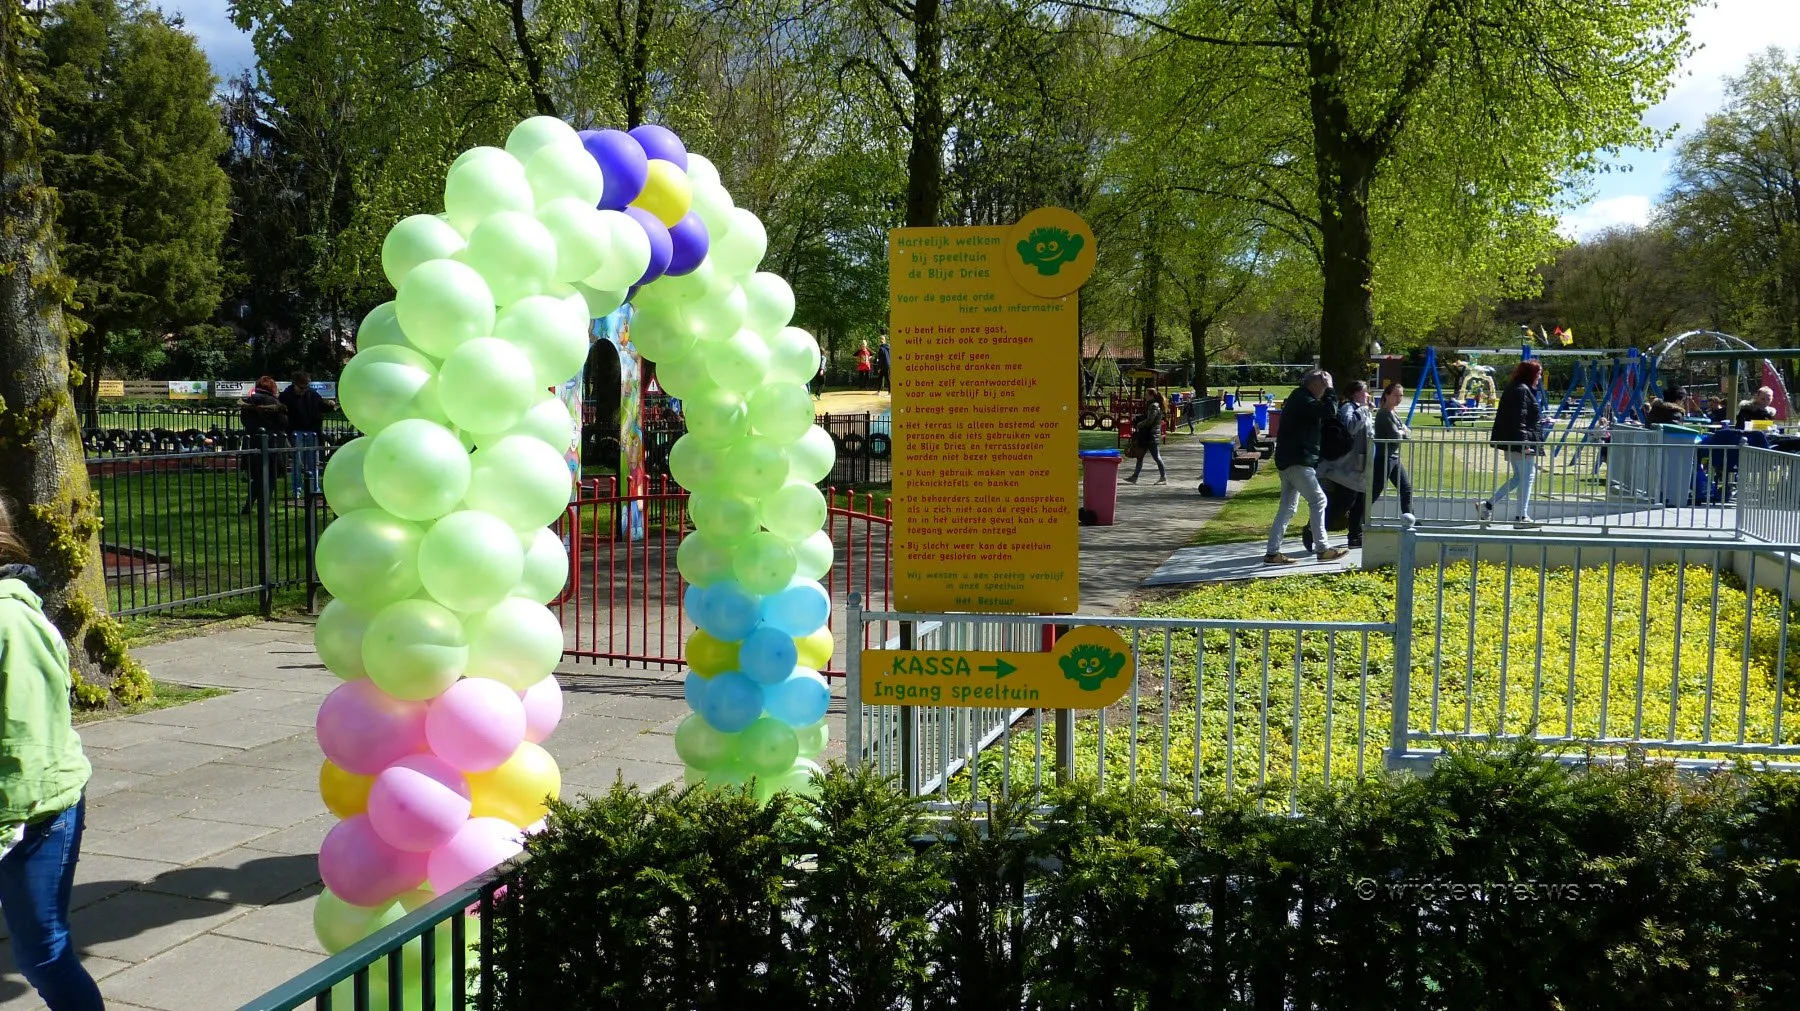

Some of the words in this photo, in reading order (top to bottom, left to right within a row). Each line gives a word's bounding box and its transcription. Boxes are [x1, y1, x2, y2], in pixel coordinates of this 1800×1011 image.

[898, 237, 949, 249] Hartelijk
[956, 236, 1000, 245] welkom
[912, 253, 927, 265] bij
[933, 253, 986, 264] speeltuin
[909, 270, 921, 278] de
[928, 269, 954, 281] Blije
[961, 269, 990, 278] Dries
[898, 294, 918, 302] Voor
[940, 294, 967, 303] goede
[959, 305, 978, 313] hier
[984, 305, 1002, 313] wat
[993, 336, 1033, 345] gedragen
[915, 353, 944, 362] brengt
[948, 352, 965, 360] zelf
[970, 353, 989, 362] geen
[965, 363, 1000, 371] dranken
[939, 379, 956, 387] zelf
[960, 378, 1037, 388] verantwoordelijk
[906, 390, 925, 398] voor
[946, 389, 979, 399] verblijf
[983, 390, 996, 398] bij
[915, 406, 944, 415] brengt
[949, 406, 968, 415] geen
[973, 405, 1018, 413] huisdieren
[968, 421, 994, 429] alleen
[999, 421, 1035, 429] bestemd
[906, 433, 945, 442] personen
[987, 432, 1030, 441] gebruiken
[921, 443, 940, 452] Blije
[964, 453, 987, 461] bezet
[992, 453, 1033, 462] gehouden
[939, 469, 973, 478] gebruik
[907, 479, 969, 489] picknicktafels
[988, 479, 1019, 487] banken
[1014, 495, 1065, 504] aanspreken
[1011, 506, 1038, 514] regels
[991, 516, 1014, 525] geval
[908, 527, 942, 535] toegang
[982, 527, 1017, 535] ontzegd
[908, 542, 919, 552] Bij
[923, 542, 949, 550] slecht
[979, 542, 994, 550] kan
[998, 542, 1007, 550] de
[1012, 542, 1051, 551] speeltuin
[940, 553, 976, 561] gesloten
[892, 656, 971, 676] KASSA
[874, 681, 941, 701] Ingang
[952, 685, 1039, 702] speeltuin
